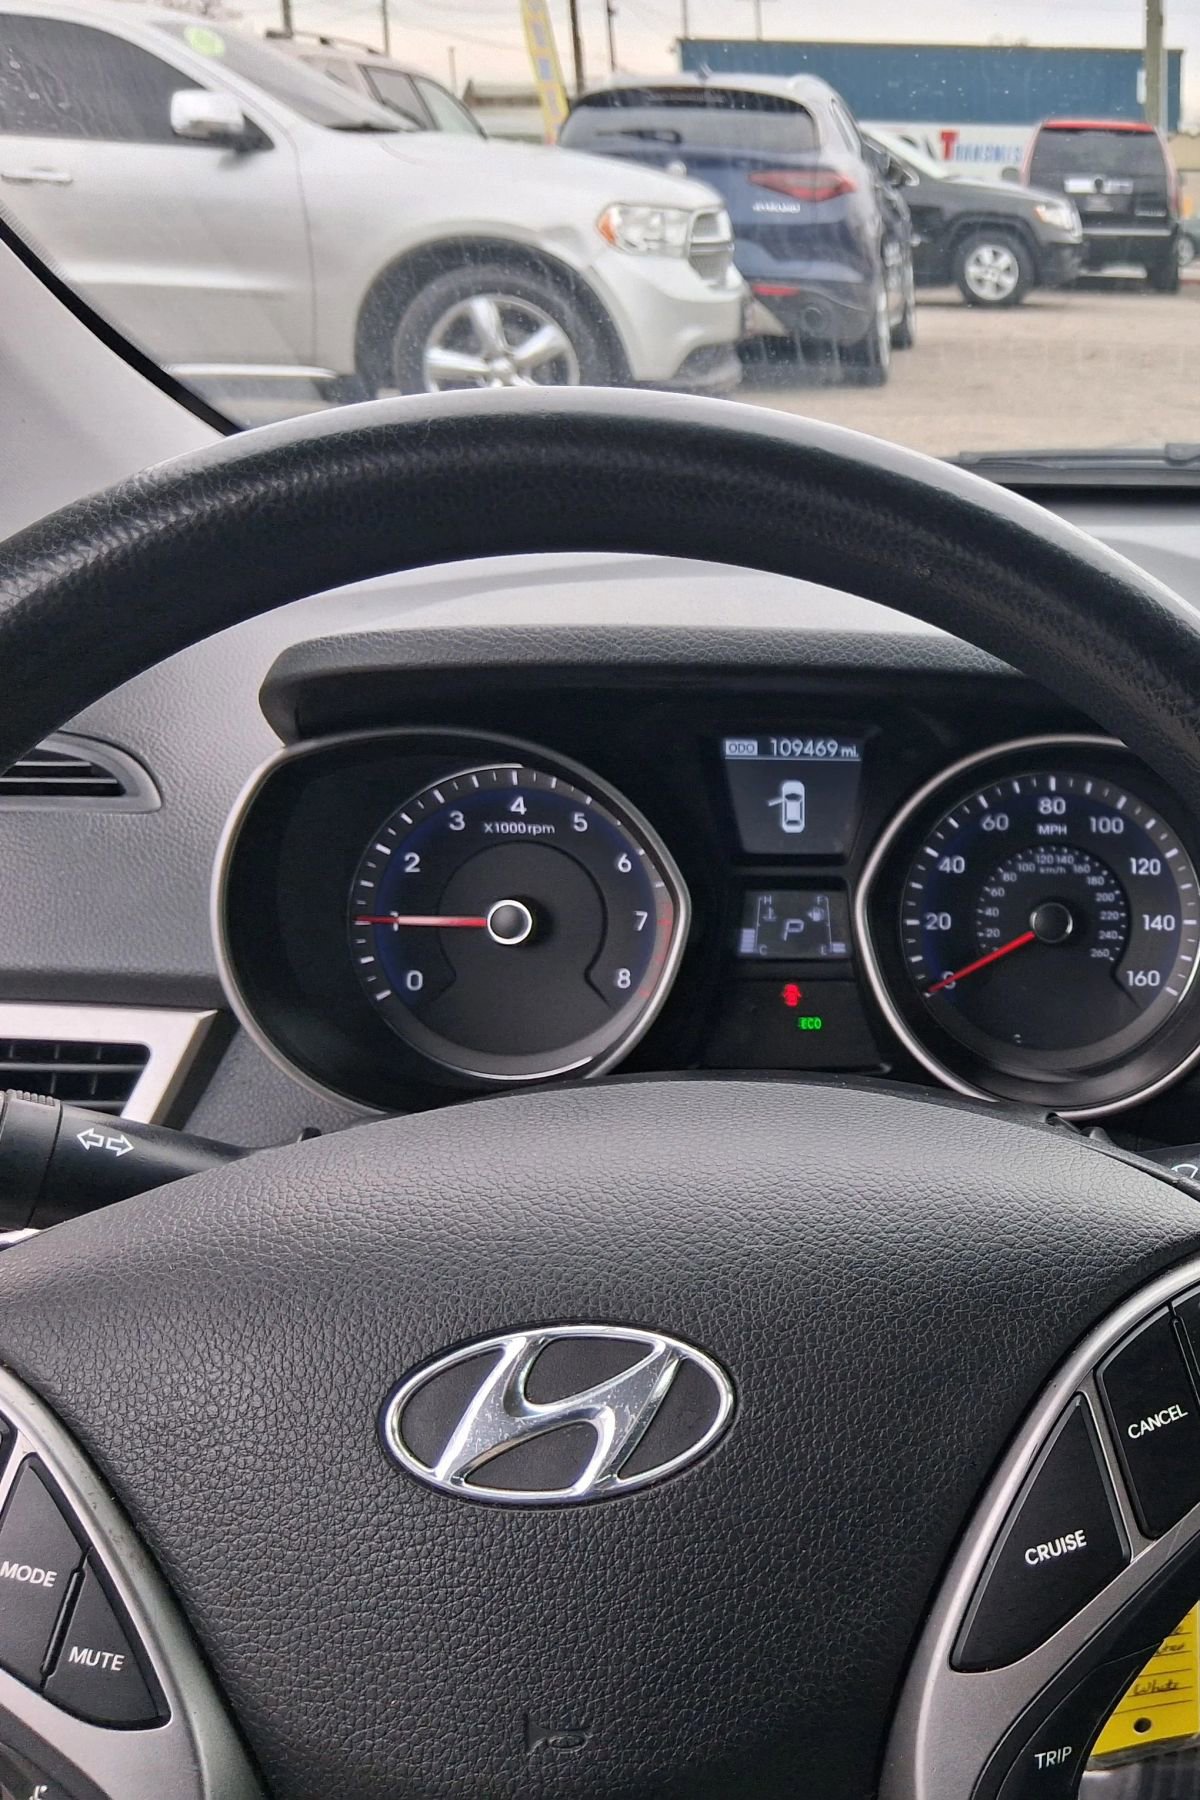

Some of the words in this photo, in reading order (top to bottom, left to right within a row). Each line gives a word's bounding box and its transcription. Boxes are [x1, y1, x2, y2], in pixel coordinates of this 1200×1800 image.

[727, 741, 757, 755] ODO
[770, 738, 838, 757] 109469
[510, 796, 527, 815] 4
[1038, 797, 1066, 815] 80
[449, 811, 465, 831] 3
[573, 813, 588, 832] 5
[981, 813, 1009, 832] 60
[1038, 824, 1067, 836] MPH
[1090, 817, 1124, 835] 100
[404, 853, 420, 873] 2
[617, 854, 632, 873] 6
[939, 855, 965, 874] 40
[1017, 863, 1036, 872] 100
[1036, 855, 1054, 864] 120
[1055, 855, 1074, 865] 140
[1073, 864, 1091, 873] 160
[1130, 857, 1161, 876] 120
[1002, 873, 1017, 882] 80
[1086, 876, 1105, 886] 180
[763, 895, 772, 905] H
[990, 888, 1005, 897] 60
[1096, 893, 1115, 902] 200
[634, 911, 649, 931] 7
[925, 912, 952, 930] 20
[985, 908, 999, 917] 40
[1100, 911, 1119, 920] 220
[784, 919, 804, 941] P
[1142, 914, 1175, 931] 140
[986, 928, 1000, 938] 20
[1099, 931, 1118, 940] 240
[759, 945, 768, 956] C
[1090, 949, 1110, 958] 260
[406, 970, 423, 991] 0
[616, 968, 631, 988] 8
[1126, 970, 1160, 986] 160
[801, 1017, 822, 1029] ECO
[1128, 1404, 1189, 1439] CANCEL
[1025, 1529, 1087, 1565] CRUISE
[0, 1561, 57, 1587] MODE
[68, 1646, 125, 1671] MUTE
[1034, 1746, 1072, 1770] TRIP
